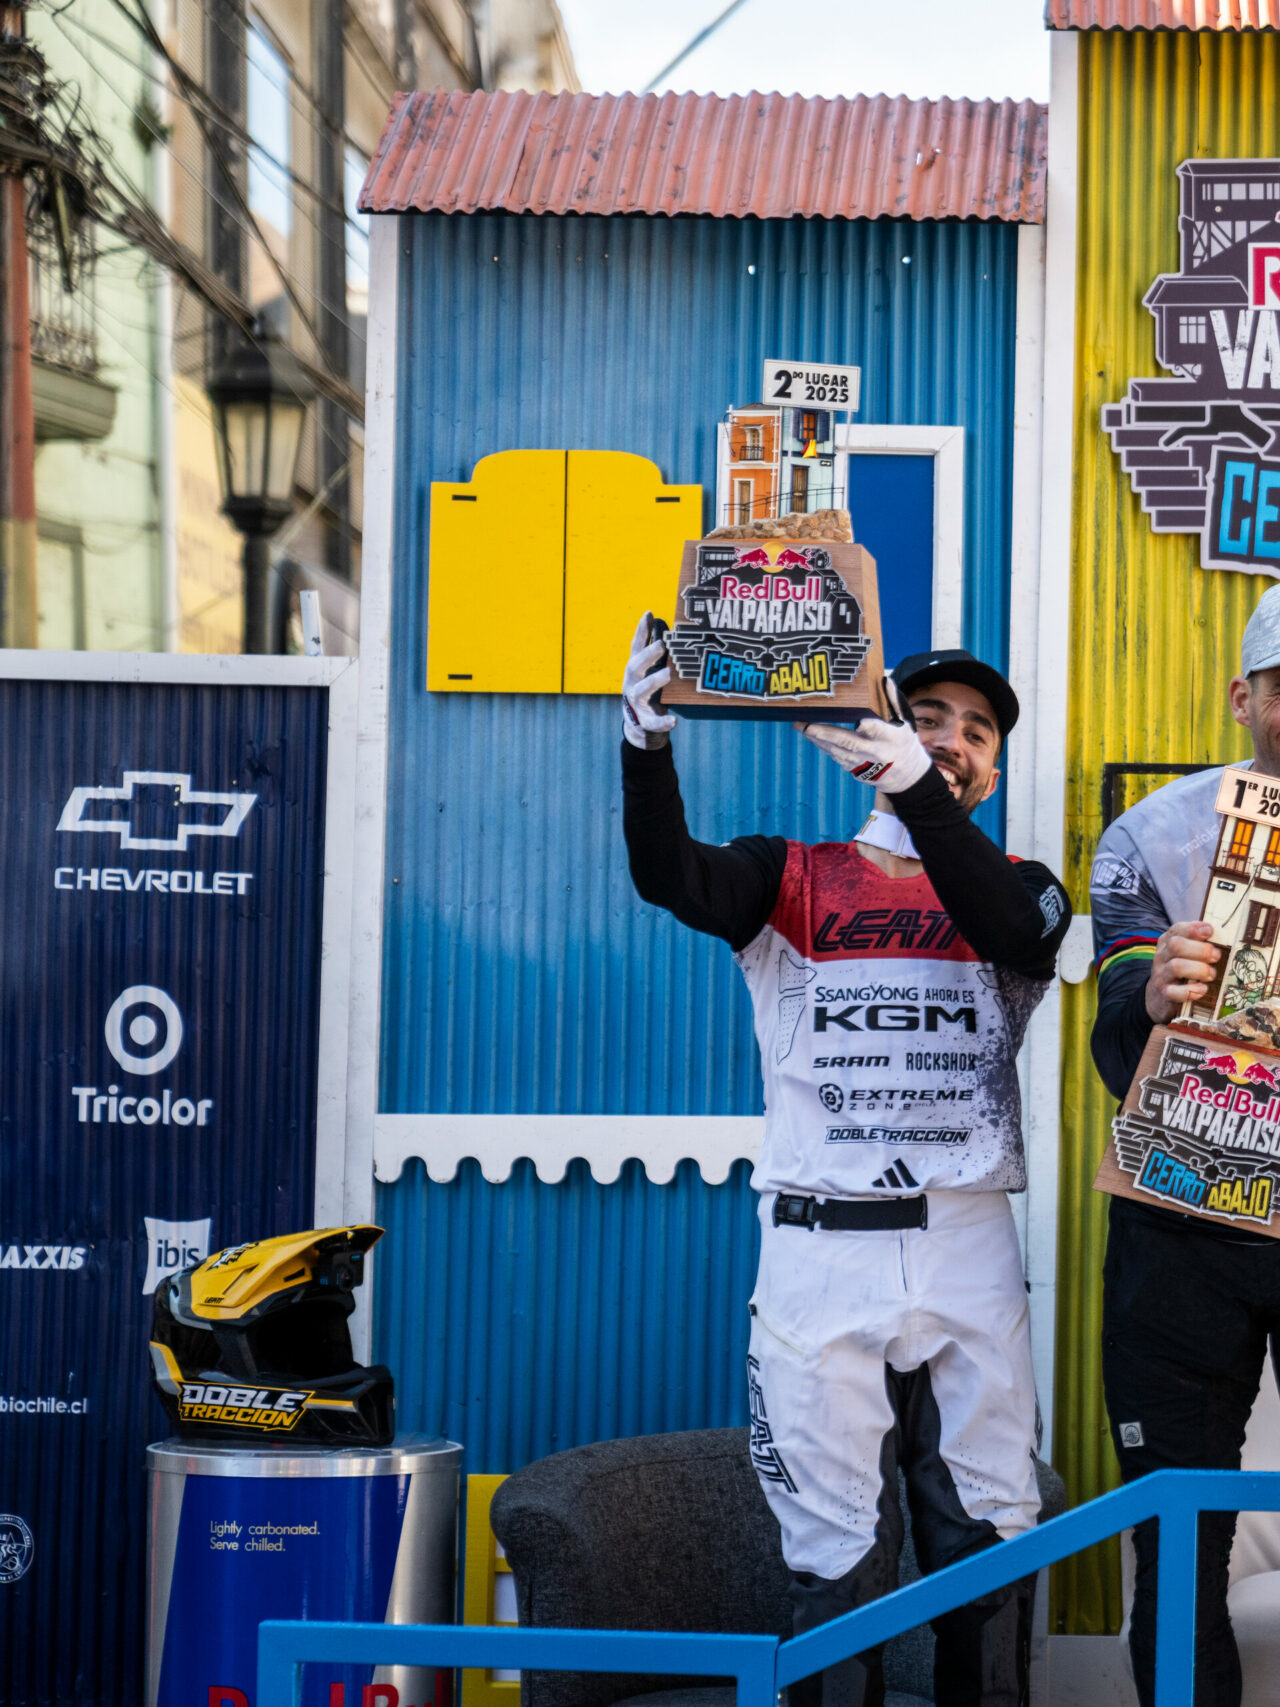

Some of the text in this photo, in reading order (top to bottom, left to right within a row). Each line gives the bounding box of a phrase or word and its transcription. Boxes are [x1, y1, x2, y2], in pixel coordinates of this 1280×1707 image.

[805, 373, 848, 388] LUGAR
[804, 386, 849, 403] 2025
[721, 576, 821, 601] Red Bull
[704, 600, 832, 632] VALPARAISO
[704, 653, 829, 695] CERRO ABAJO
[54, 867, 253, 895] CHEVROLET
[924, 988, 960, 1003] AHORA
[962, 990, 975, 1004] ES
[813, 1004, 978, 1034] KGM
[812, 1052, 976, 1071] SRAM ROCKSHOX
[72, 1084, 213, 1126] Tricolor
[849, 1089, 974, 1101] EXTREME
[1180, 1073, 1233, 1112] Red
[1142, 1151, 1271, 1218] CERRO ABAJO
[0, 1244, 86, 1270] AXXIS
[157, 1239, 200, 1268] ibis
[181, 1384, 307, 1412] DOBLE
[181, 1403, 296, 1427] TRACCION
[210, 1520, 320, 1537] Lightly carbonated.
[210, 1537, 286, 1551] Serve chilled.
